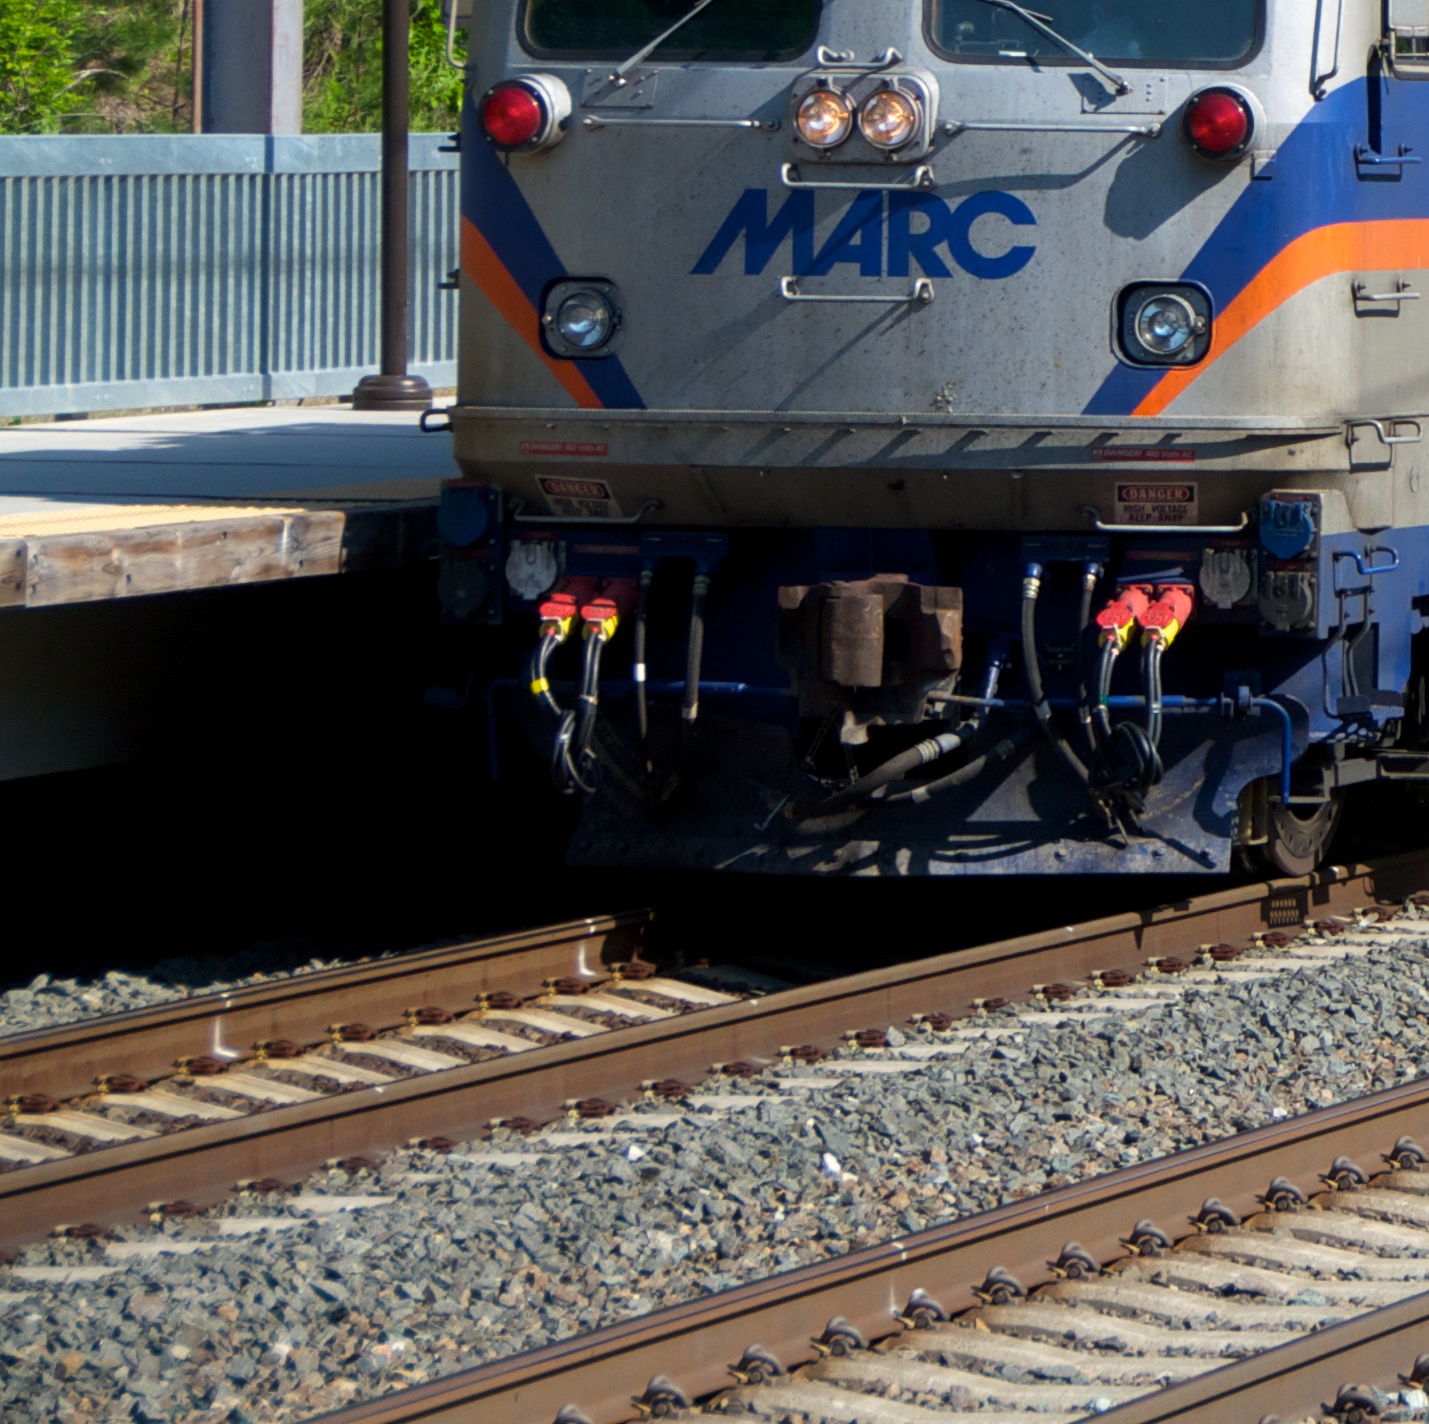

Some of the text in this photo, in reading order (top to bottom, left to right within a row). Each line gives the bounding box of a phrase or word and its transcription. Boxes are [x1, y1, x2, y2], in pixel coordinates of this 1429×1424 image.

[689, 188, 1037, 279] MARC
[549, 481, 601, 496] DANGER
[1129, 487, 1184, 501] DANGER
[1123, 505, 1189, 514] HIGH VOLTAGE
[1129, 514, 1184, 522] KEEP AWAY
